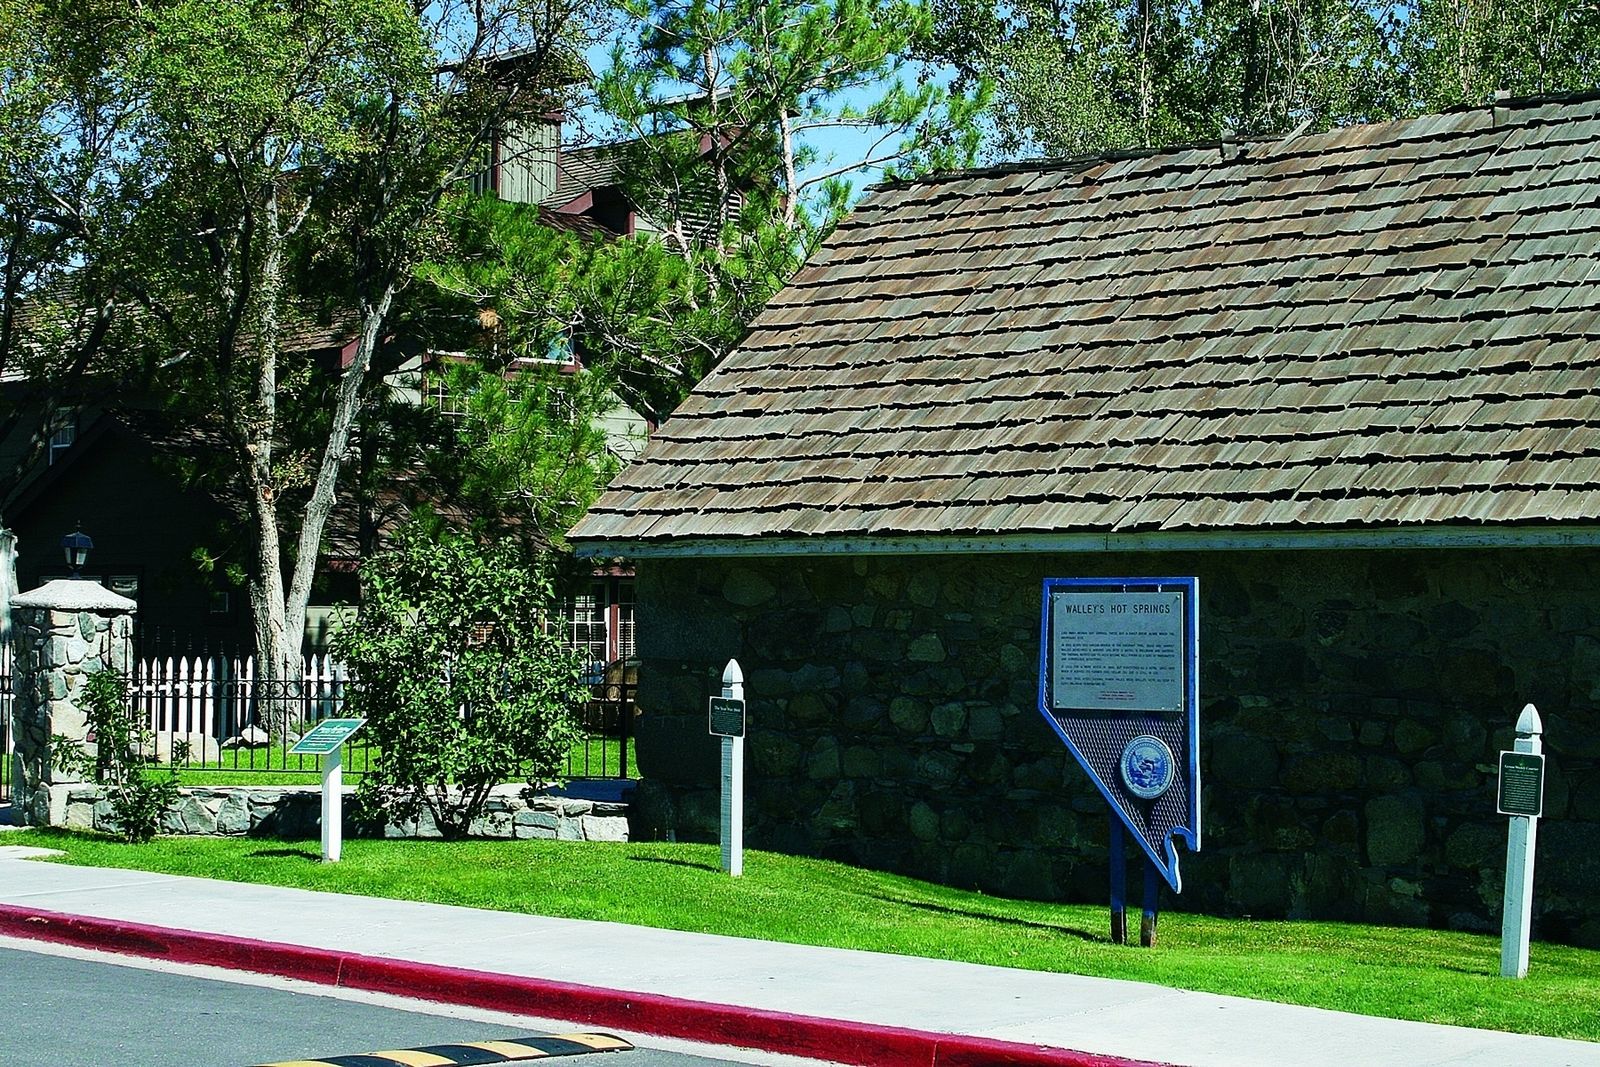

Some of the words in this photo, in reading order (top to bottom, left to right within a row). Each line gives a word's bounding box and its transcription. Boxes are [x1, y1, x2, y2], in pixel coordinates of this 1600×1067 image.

[1065, 604, 1105, 614] WALLEY'S
[1110, 604, 1128, 614] HOT
[1132, 604, 1171, 614] SPRINGS
